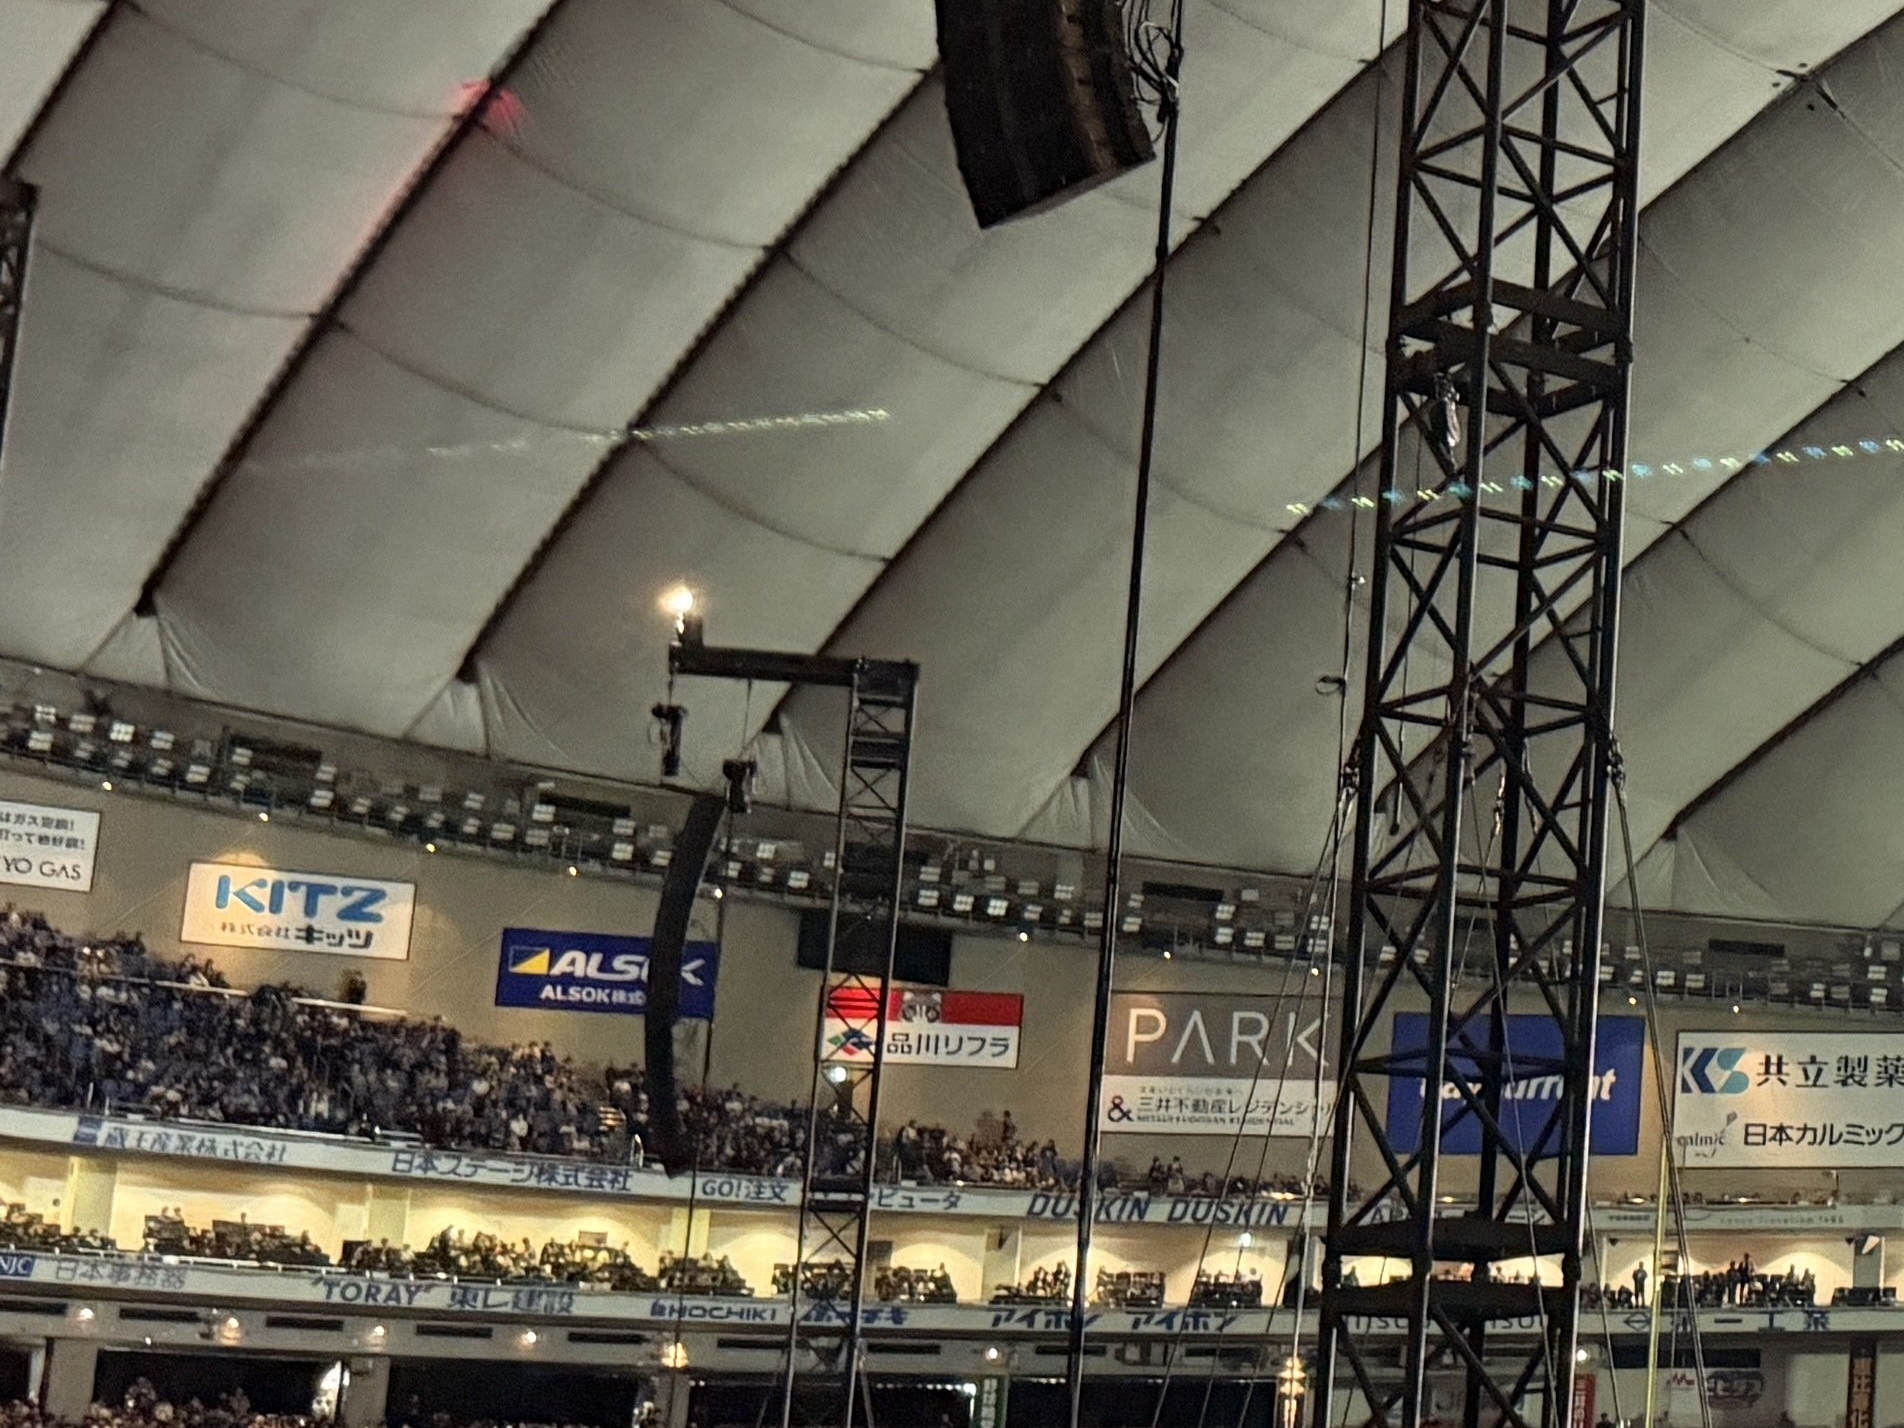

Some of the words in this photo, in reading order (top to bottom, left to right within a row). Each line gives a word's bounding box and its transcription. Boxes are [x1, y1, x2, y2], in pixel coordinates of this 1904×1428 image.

[0, 855, 33, 874] YO
[39, 860, 82, 881] GAS
[215, 874, 387, 924] KITZ
[887, 1032, 1010, 1058] 品川リフラ
[1126, 1007, 1331, 1068] PARK
[391, 1150, 633, 1192] 日本ステージ株式会社
[1166, 1199, 1290, 1224] DUSKIN
